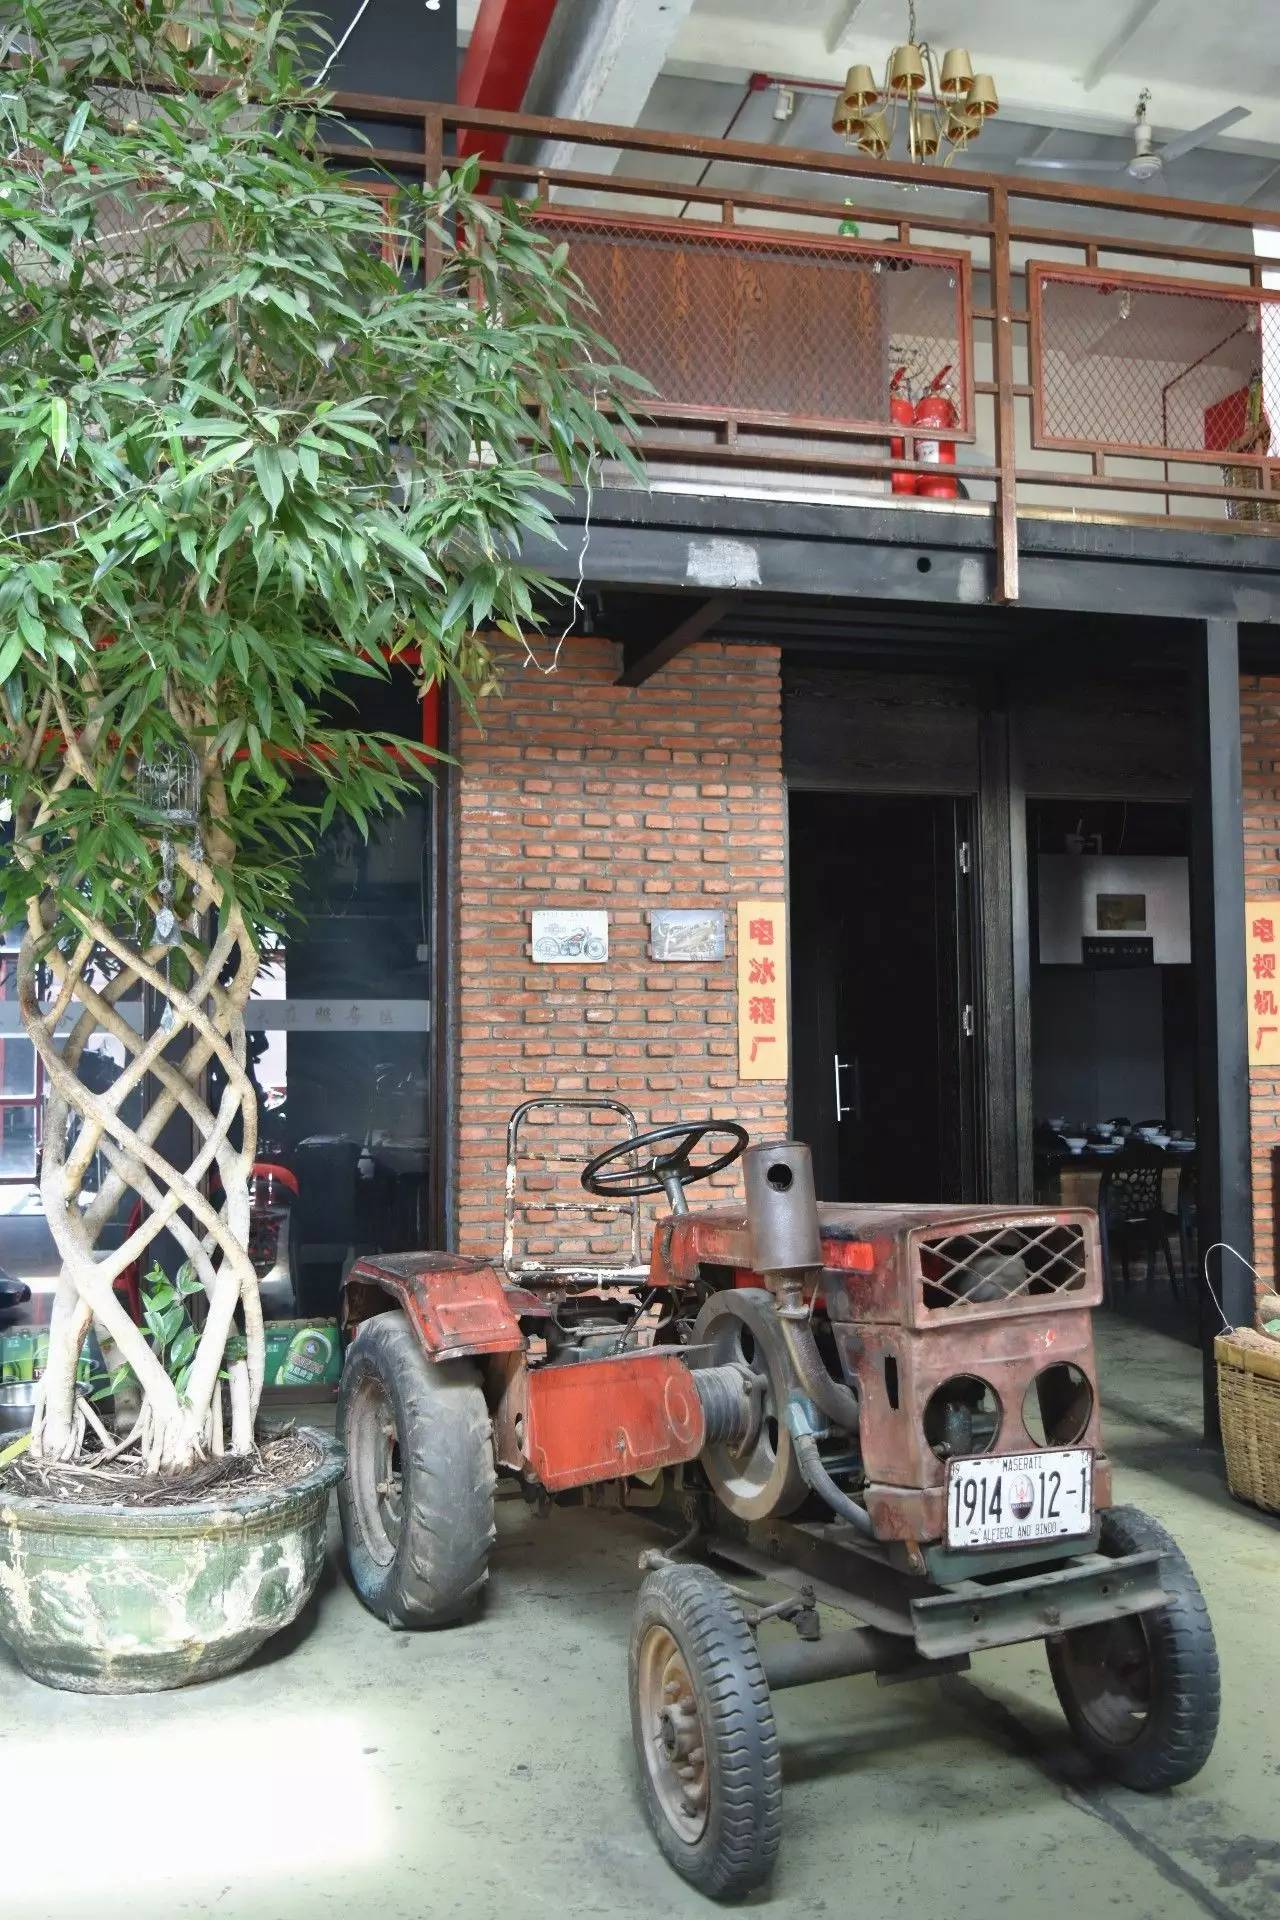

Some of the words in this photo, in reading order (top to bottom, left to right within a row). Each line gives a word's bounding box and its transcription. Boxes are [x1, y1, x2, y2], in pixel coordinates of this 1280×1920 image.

[1252, 917, 1278, 1051] 电视机厂
[1002, 1455, 1042, 1473] MASERATI
[954, 1475, 1002, 1528] 1914
[983, 1524, 1013, 1541] ALFIERI
[1017, 1523, 1031, 1537] AND
[1035, 1521, 1057, 1536] BINDO
